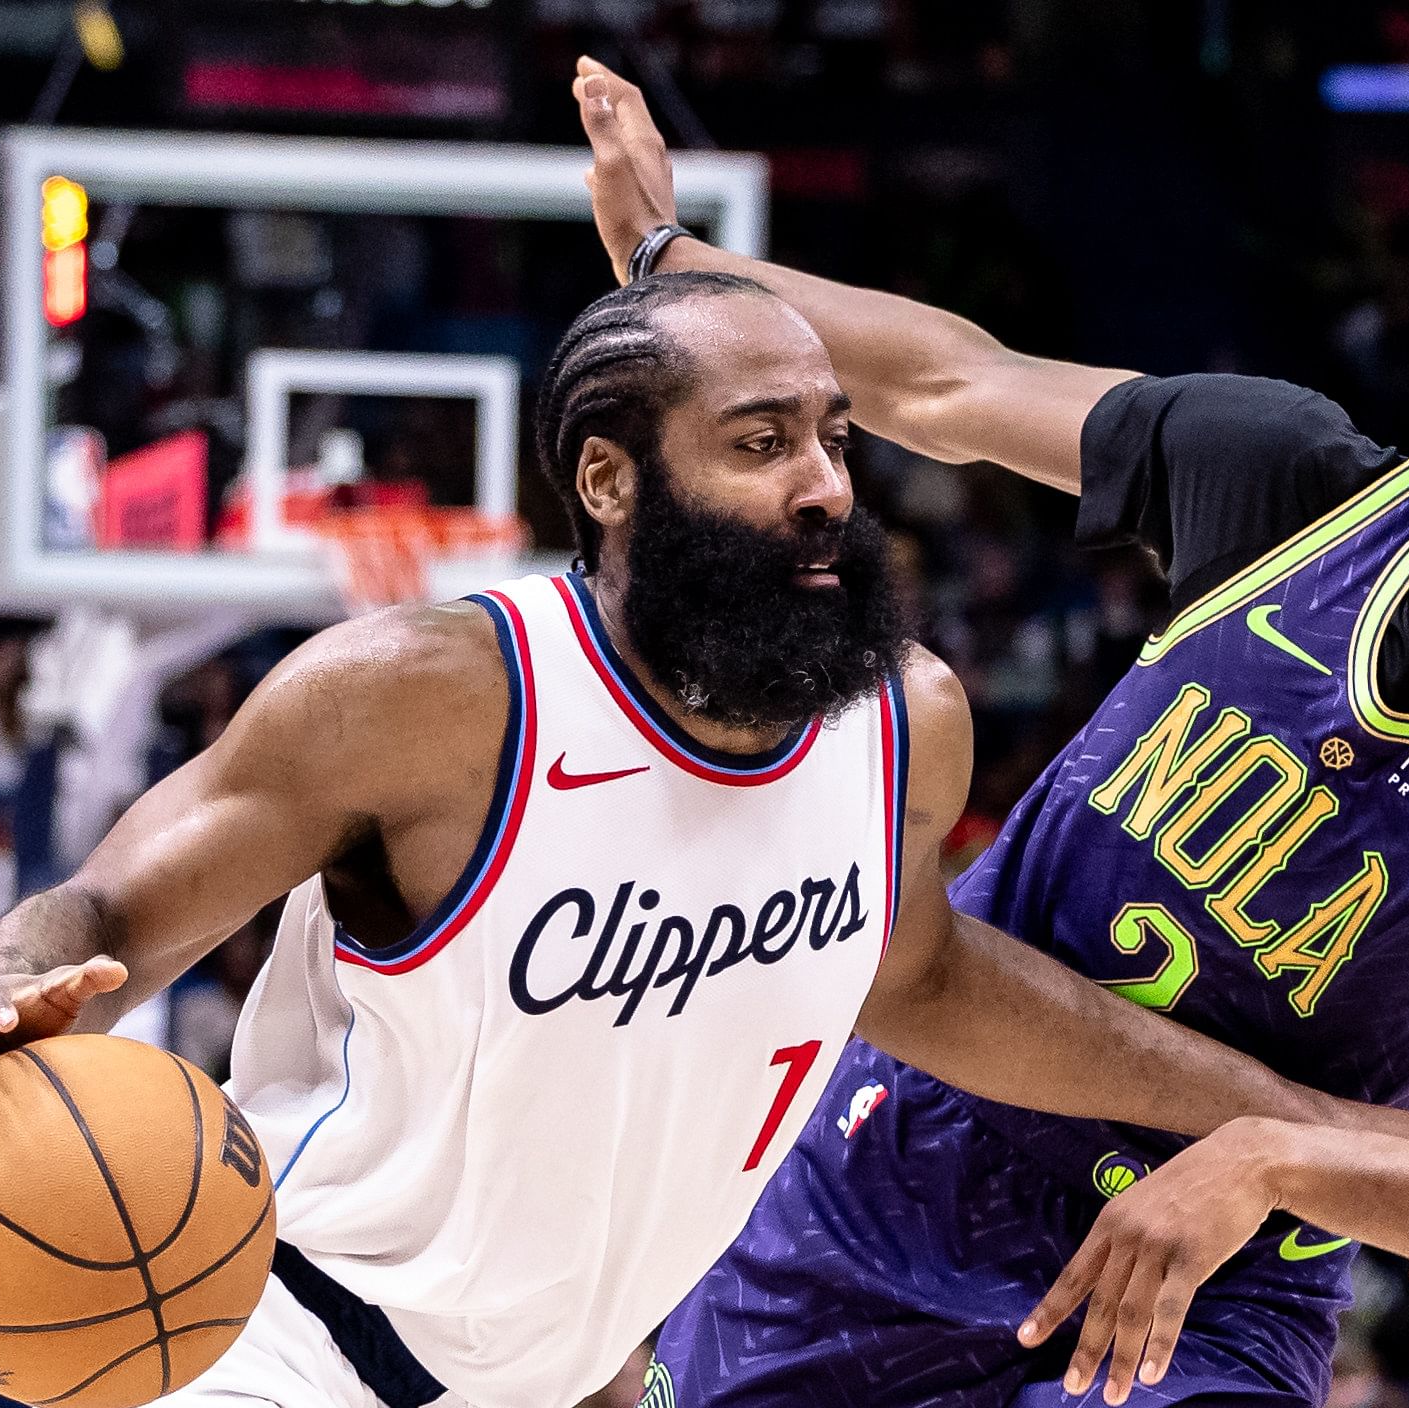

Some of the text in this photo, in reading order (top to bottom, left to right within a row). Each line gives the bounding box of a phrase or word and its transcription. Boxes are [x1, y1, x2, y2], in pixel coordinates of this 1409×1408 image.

[1088, 681, 1390, 1020] NOLA
[507, 859, 871, 1029] Clippers
[1093, 902, 1200, 1012] 2
[742, 1039, 824, 1174] 1
